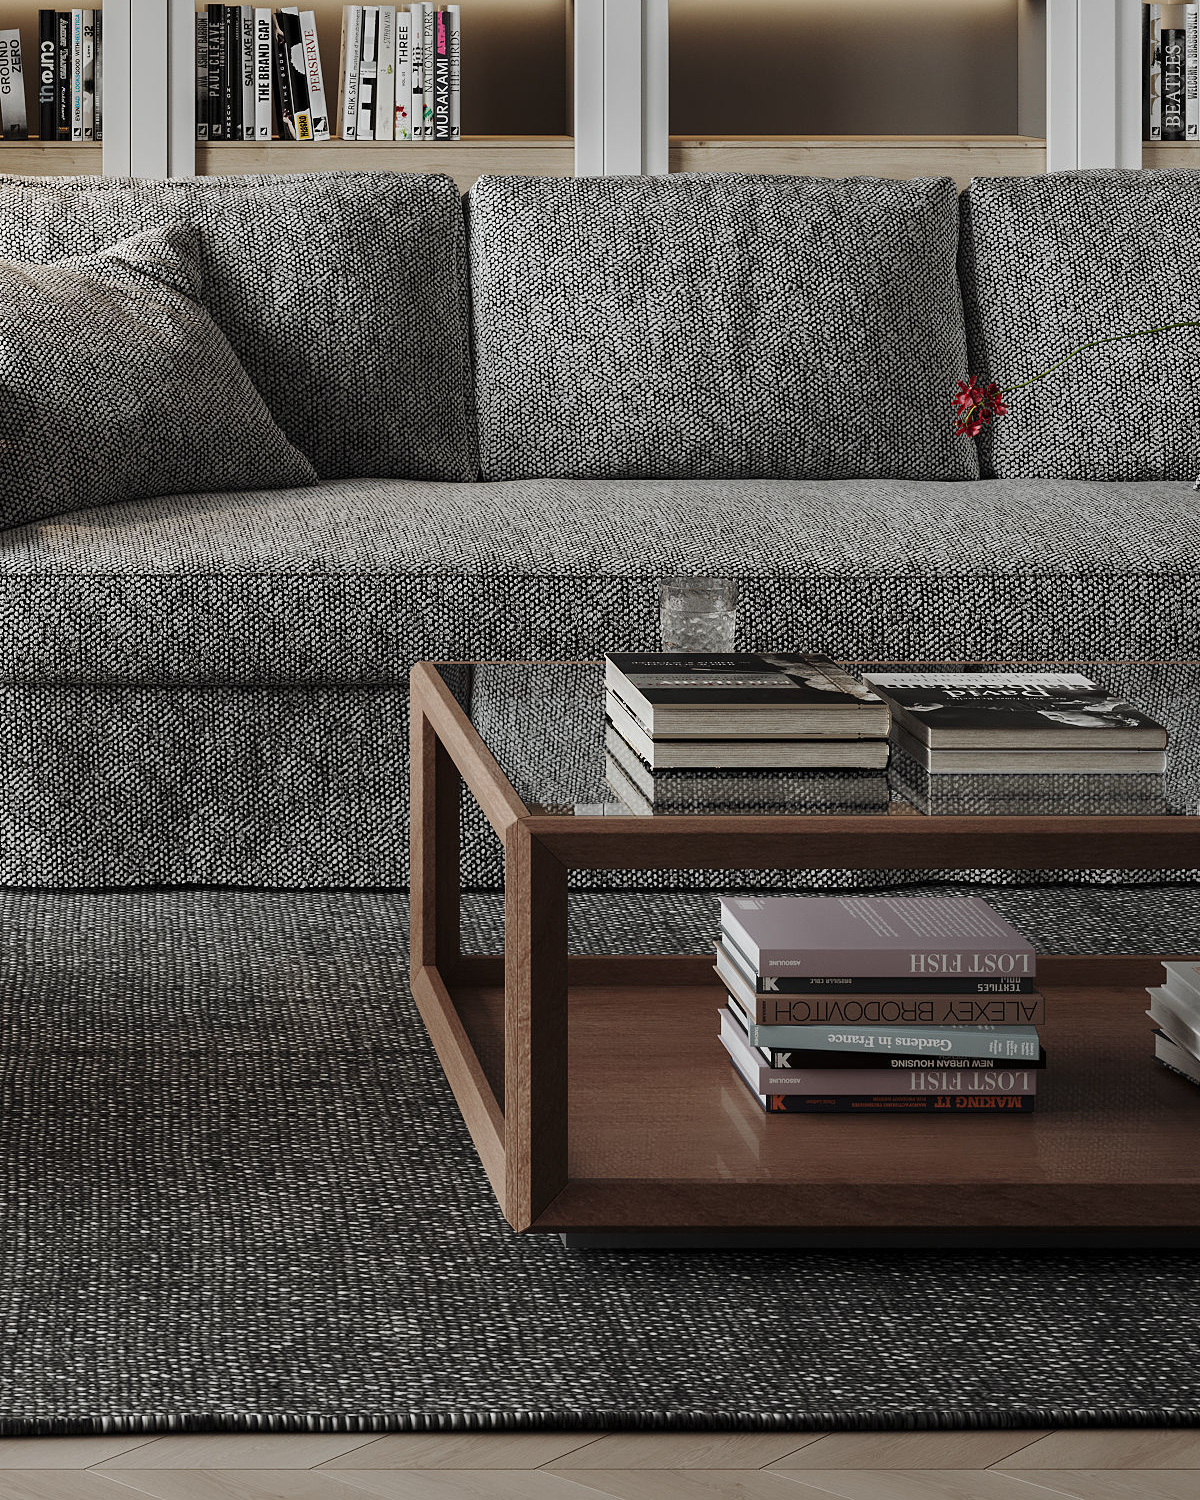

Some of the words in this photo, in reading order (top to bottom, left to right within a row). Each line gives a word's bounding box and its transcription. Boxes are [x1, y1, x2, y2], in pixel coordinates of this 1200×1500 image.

[258, 20, 270, 40] GAP
[424, 10, 432, 37] PARK
[209, 22, 220, 65] CLEAVE
[399, 26, 408, 64] THREE
[10, 39, 21, 73] ZERO
[258, 44, 270, 80] BRAND
[304, 29, 321, 92] PERSERVE
[424, 40, 433, 93] NATIONAL
[209, 68, 220, 97] PAUL
[258, 82, 270, 102] THE
[348, 72, 357, 94] SATIE
[1166, 44, 1181, 128] BEATLES
[348, 97, 356, 115] ERIK
[436, 58, 449, 138] MURAKAMI
[942, 689, 1050, 698] David
[908, 954, 962, 972] FISH
[968, 954, 1030, 972] LOST
[977, 983, 1021, 992] TEXTILES
[776, 1002, 934, 1021] BRODOVITCH
[942, 1002, 1038, 1021] ALEXEY
[828, 1032, 874, 1046] France
[878, 1037, 892, 1046] in
[894, 1035, 952, 1051] Gardens
[891, 1060, 939, 1068] HOUSING
[941, 1060, 970, 1068] URBAN
[972, 1060, 994, 1068] NEW
[909, 1071, 963, 1091] FISH
[968, 1071, 1030, 1091] LOST
[934, 1096, 952, 1108] IT
[955, 1096, 1023, 1108] MAKING
